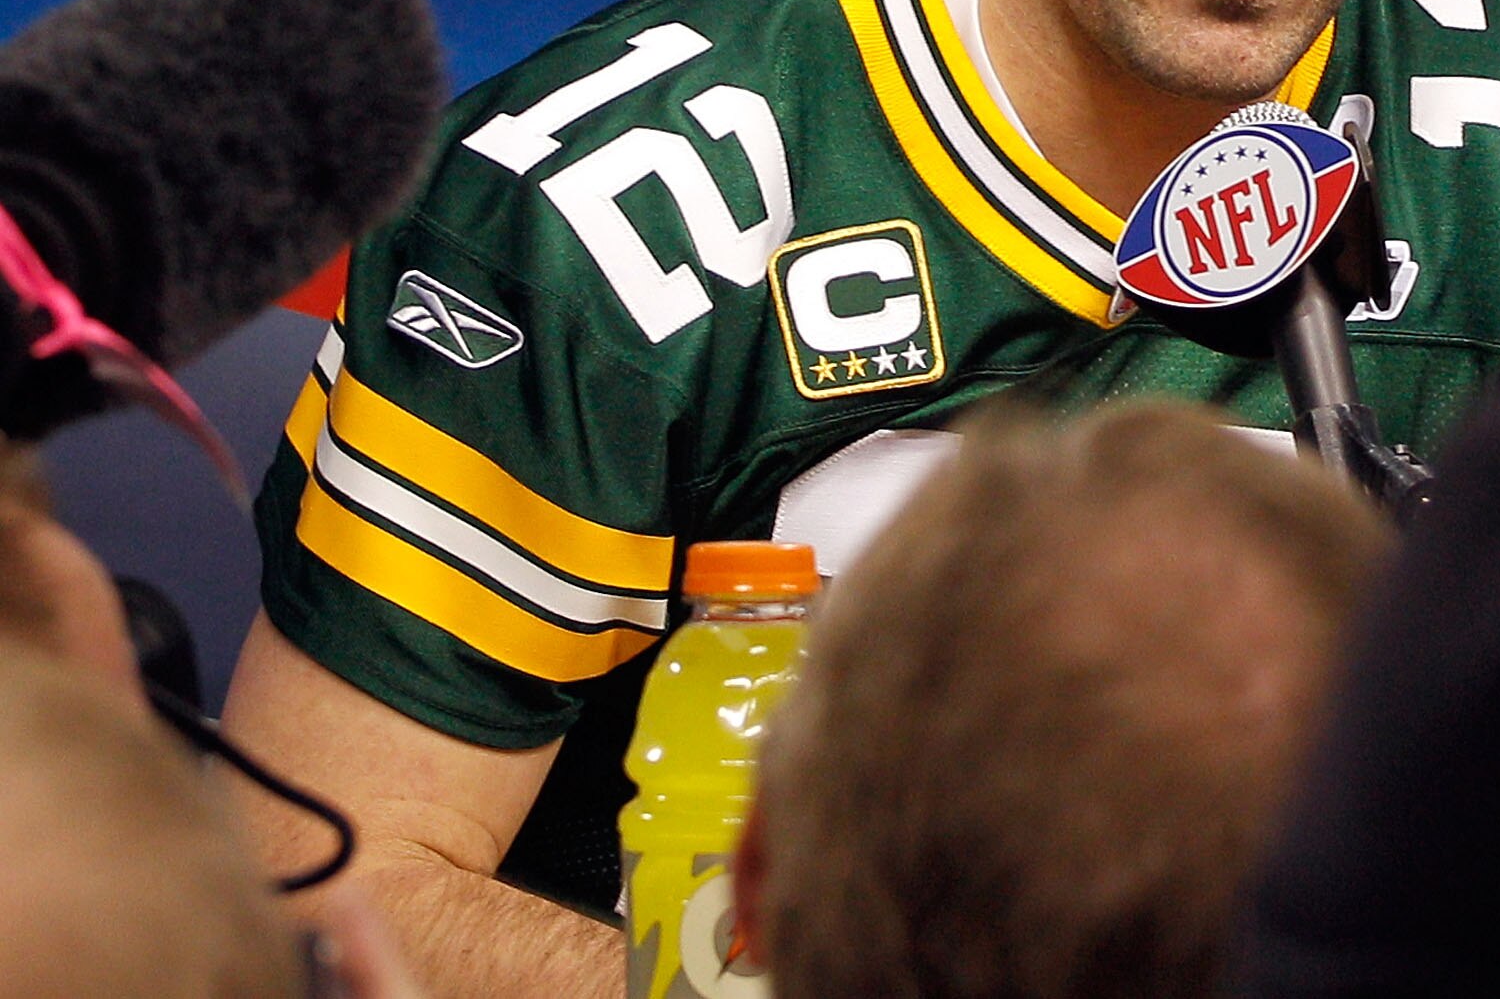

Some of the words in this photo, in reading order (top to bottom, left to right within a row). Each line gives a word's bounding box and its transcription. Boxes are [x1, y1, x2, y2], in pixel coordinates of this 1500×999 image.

[461, 22, 796, 344] 12
[1174, 169, 1299, 275] NFL
[786, 238, 922, 353] C
